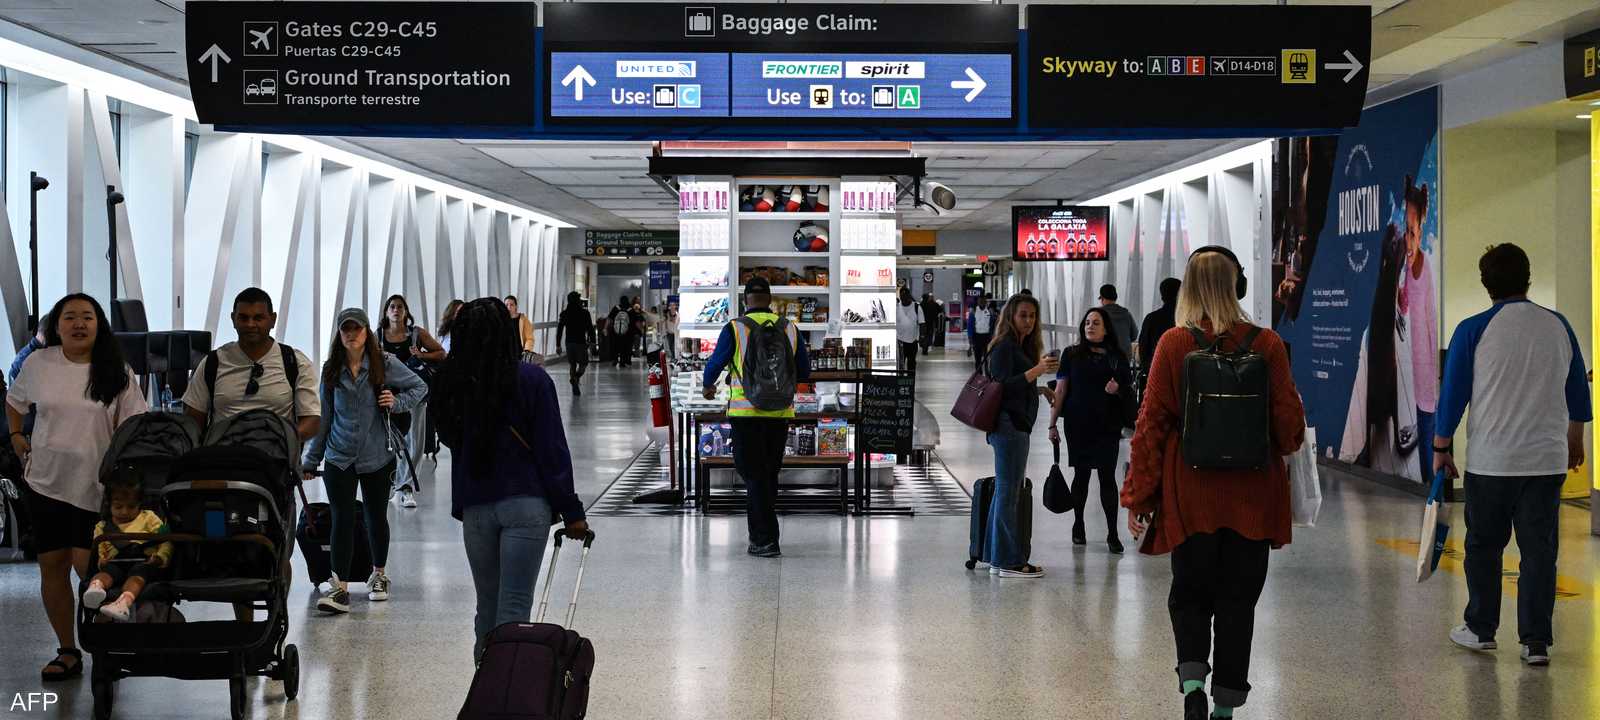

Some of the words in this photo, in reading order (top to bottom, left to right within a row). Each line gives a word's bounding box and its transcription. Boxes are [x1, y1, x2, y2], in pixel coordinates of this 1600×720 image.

[286, 22, 341, 37] Gates
[350, 22, 436, 37] C29-C45
[723, 15, 808, 34] Baggage
[817, 14, 877, 30] Claim:
[286, 46, 336, 56] Puertas
[342, 46, 400, 56] C29-C45
[620, 66, 674, 74] UNITED
[765, 64, 840, 75] FRONTIER
[861, 64, 910, 77] spirit
[1043, 57, 1117, 77] Skyway
[1123, 59, 1143, 72] to:
[1152, 59, 1161, 72] A
[1172, 59, 1180, 72] B
[1192, 59, 1200, 73] E
[1231, 61, 1273, 70] D14-D18
[286, 70, 357, 85] Ground
[365, 70, 509, 90] Transportation
[285, 94, 356, 107] Transporte
[362, 95, 419, 104] terrestre
[612, 88, 650, 104] Use:
[682, 87, 695, 105] C
[768, 89, 801, 104] Use
[840, 90, 865, 105] to:
[901, 87, 918, 105] A
[1339, 185, 1379, 235] HOUSTON
